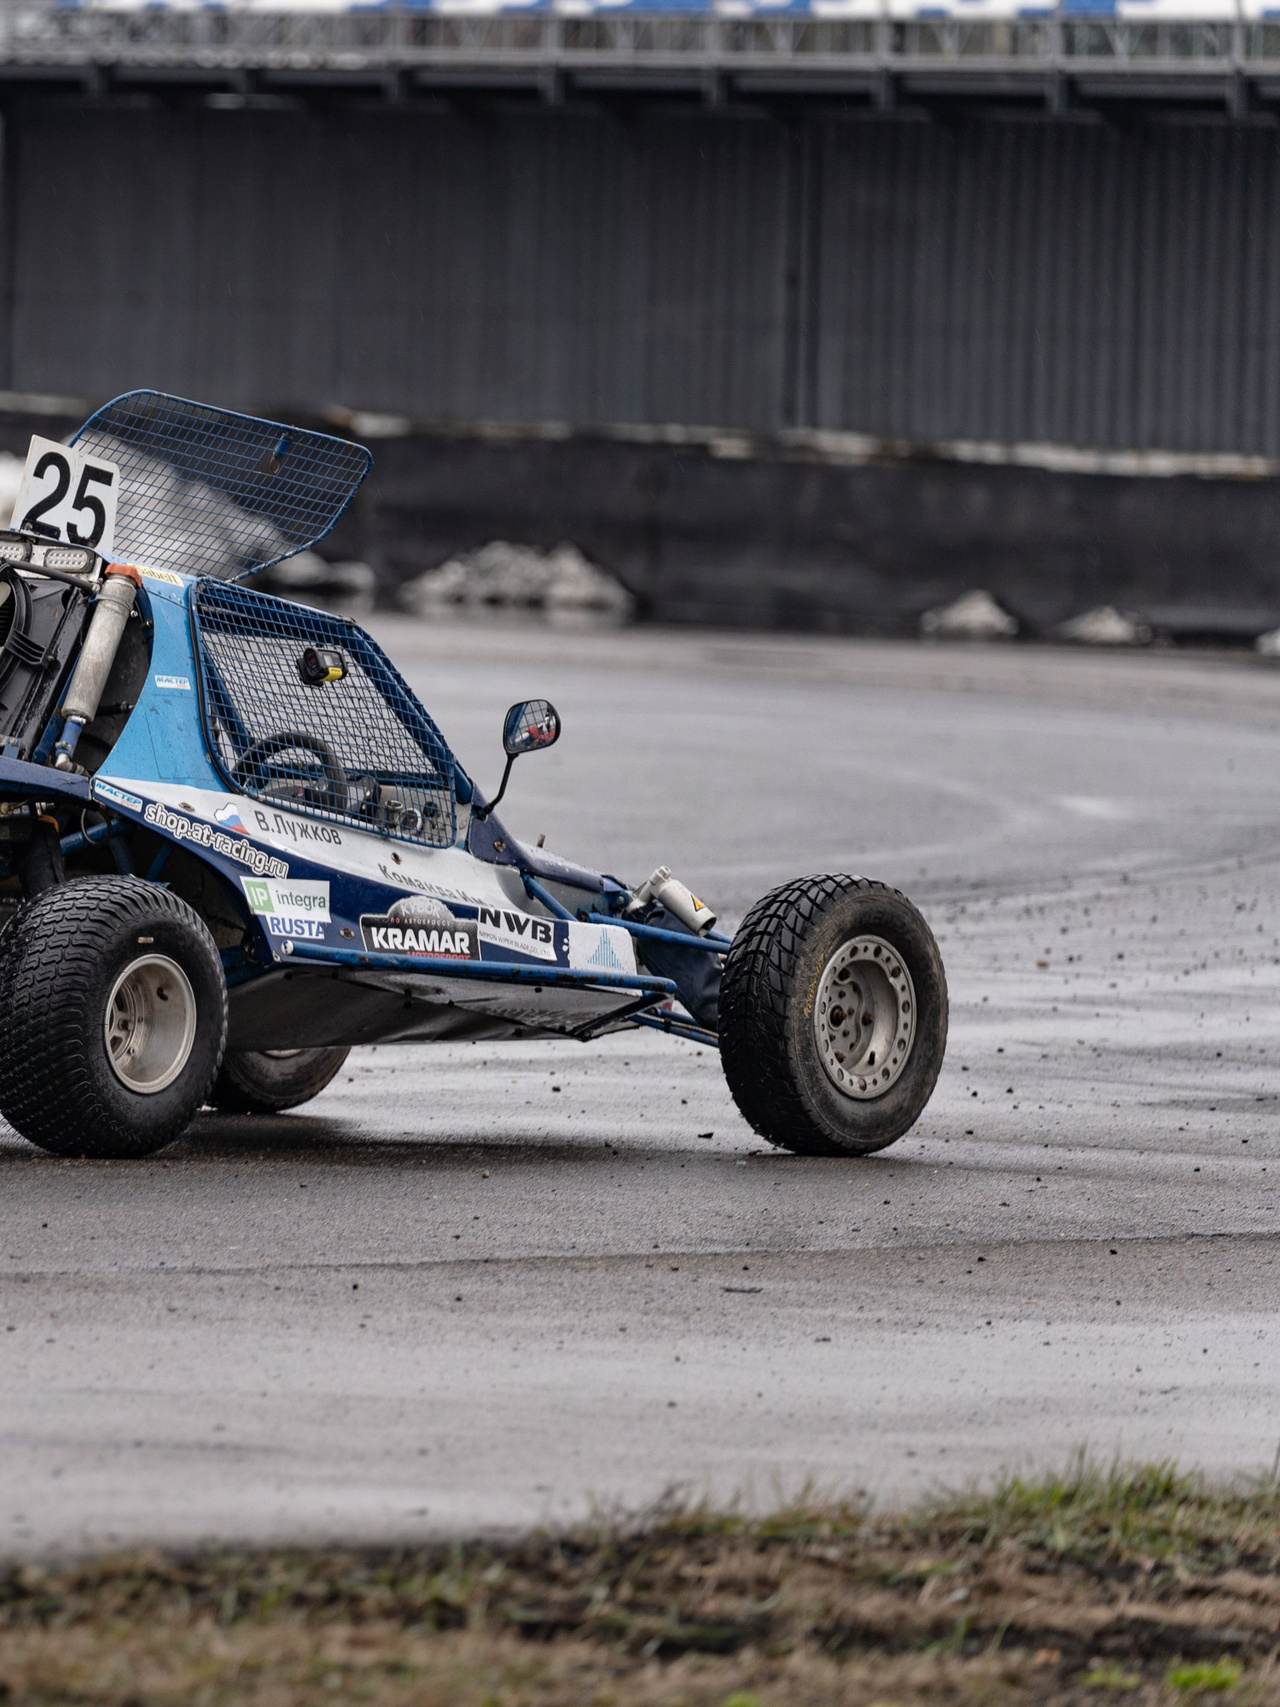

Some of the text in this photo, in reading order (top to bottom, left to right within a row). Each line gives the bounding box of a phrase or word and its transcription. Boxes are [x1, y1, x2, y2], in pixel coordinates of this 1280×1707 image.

[20, 451, 114, 548] 25
[156, 676, 188, 684] МАСТЕР
[96, 782, 141, 804] МАСТЕР
[145, 803, 288, 878] shop.at-racing.ru
[254, 810, 342, 845] В.Лужков
[378, 863, 458, 899] Команда
[249, 886, 326, 911] IP integra
[400, 901, 441, 918] КУБОК
[371, 926, 471, 954] KRAMAR
[480, 908, 552, 943] NWB
